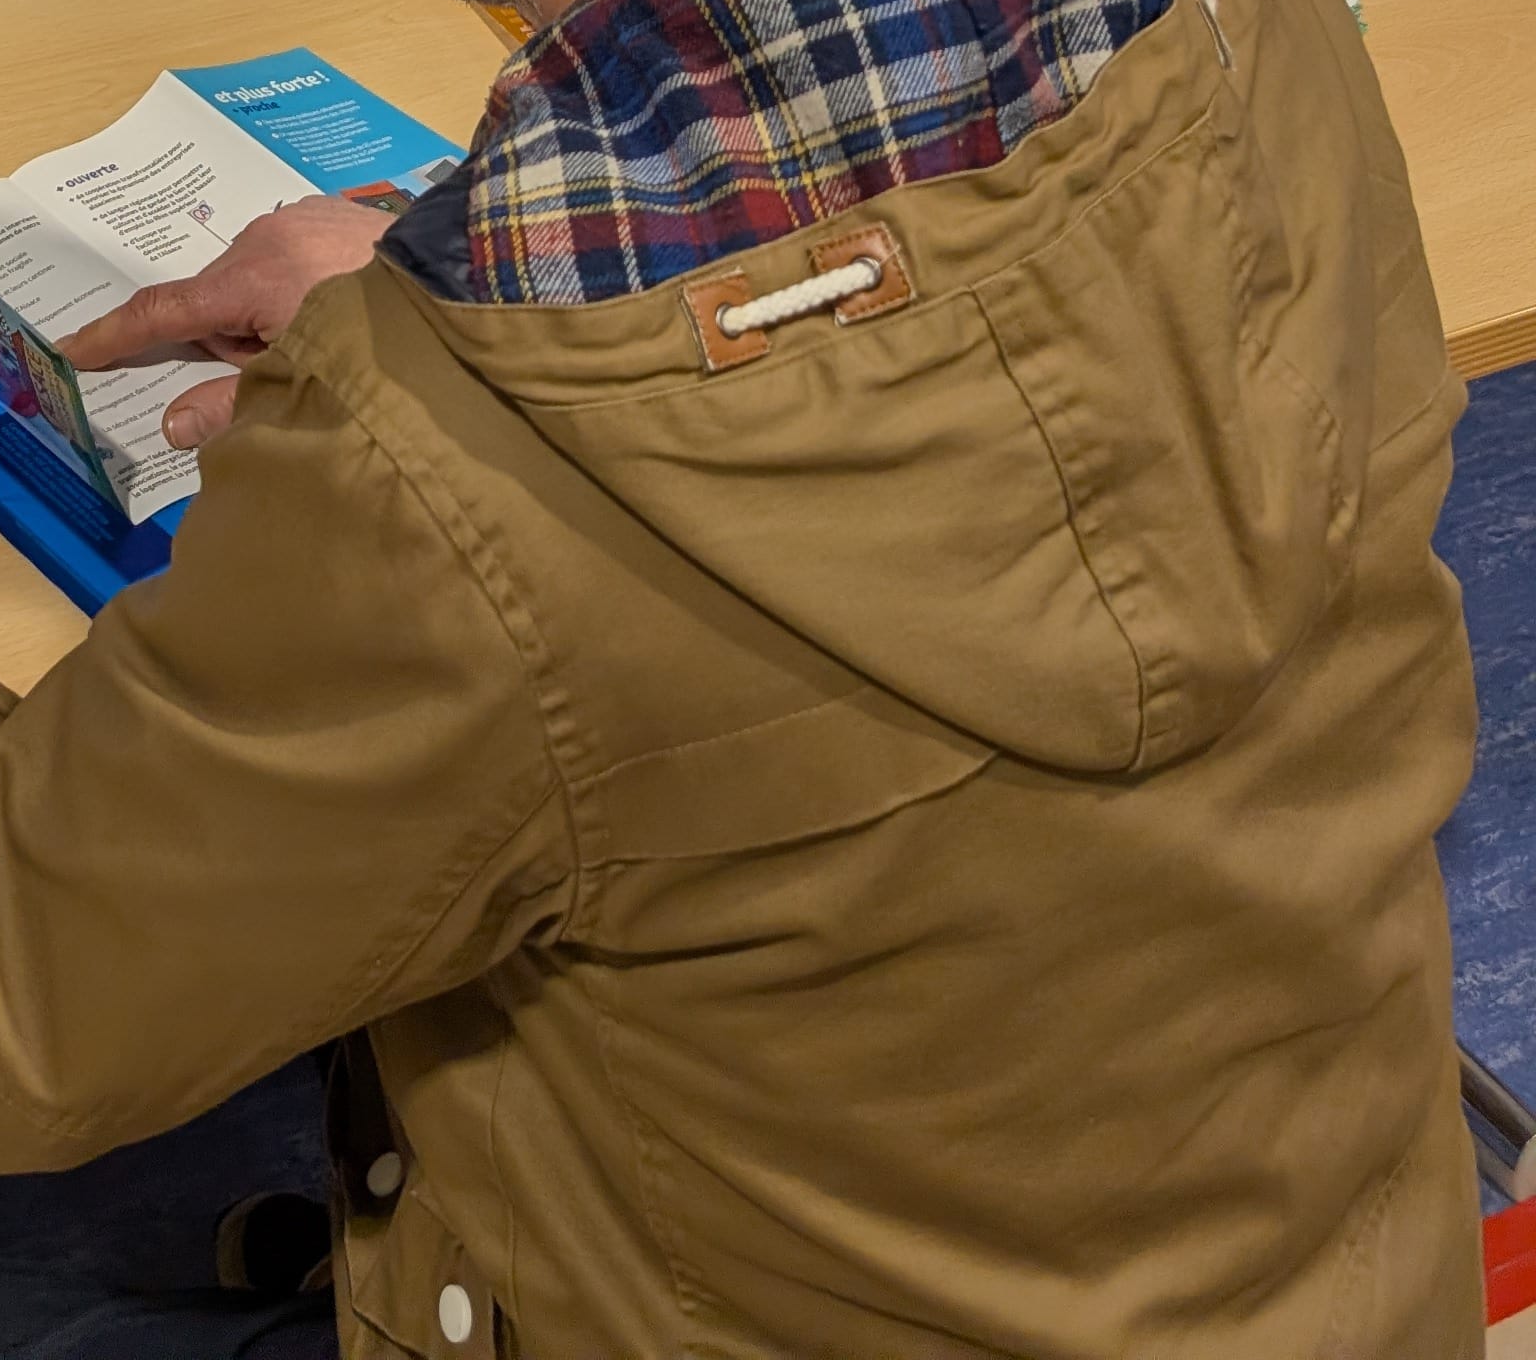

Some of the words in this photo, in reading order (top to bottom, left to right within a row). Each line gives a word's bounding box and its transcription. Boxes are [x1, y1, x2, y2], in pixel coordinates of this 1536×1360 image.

[233, 87, 276, 104] plus
[160, 141, 196, 170] entreprises
[167, 141, 183, 156] pour
[65, 163, 120, 188] ouverte
